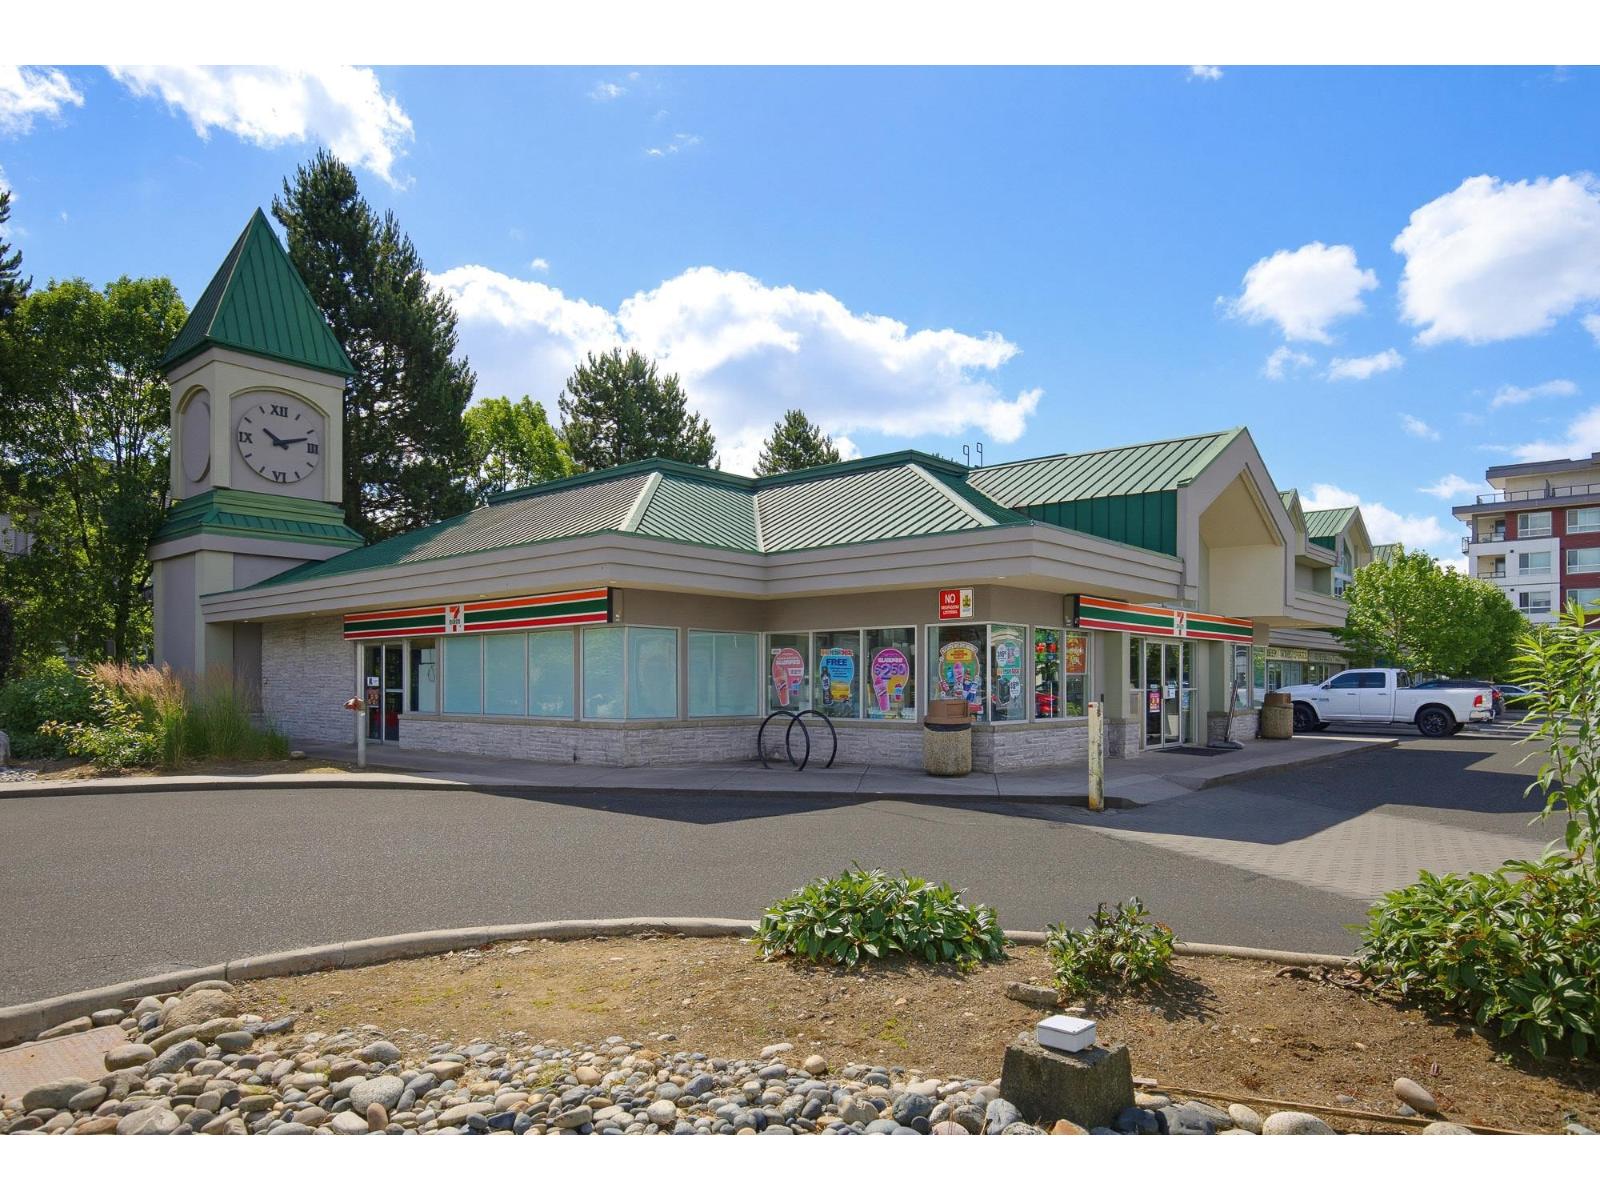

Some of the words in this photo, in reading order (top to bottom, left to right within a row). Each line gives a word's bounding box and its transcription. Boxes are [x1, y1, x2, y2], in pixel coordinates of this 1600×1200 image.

[270, 404, 288, 417] XII
[239, 432, 252, 444] IX
[307, 443, 319, 455] III
[272, 471, 287, 483] VI
[945, 593, 956, 604] NO
[826, 658, 848, 666] FREE
